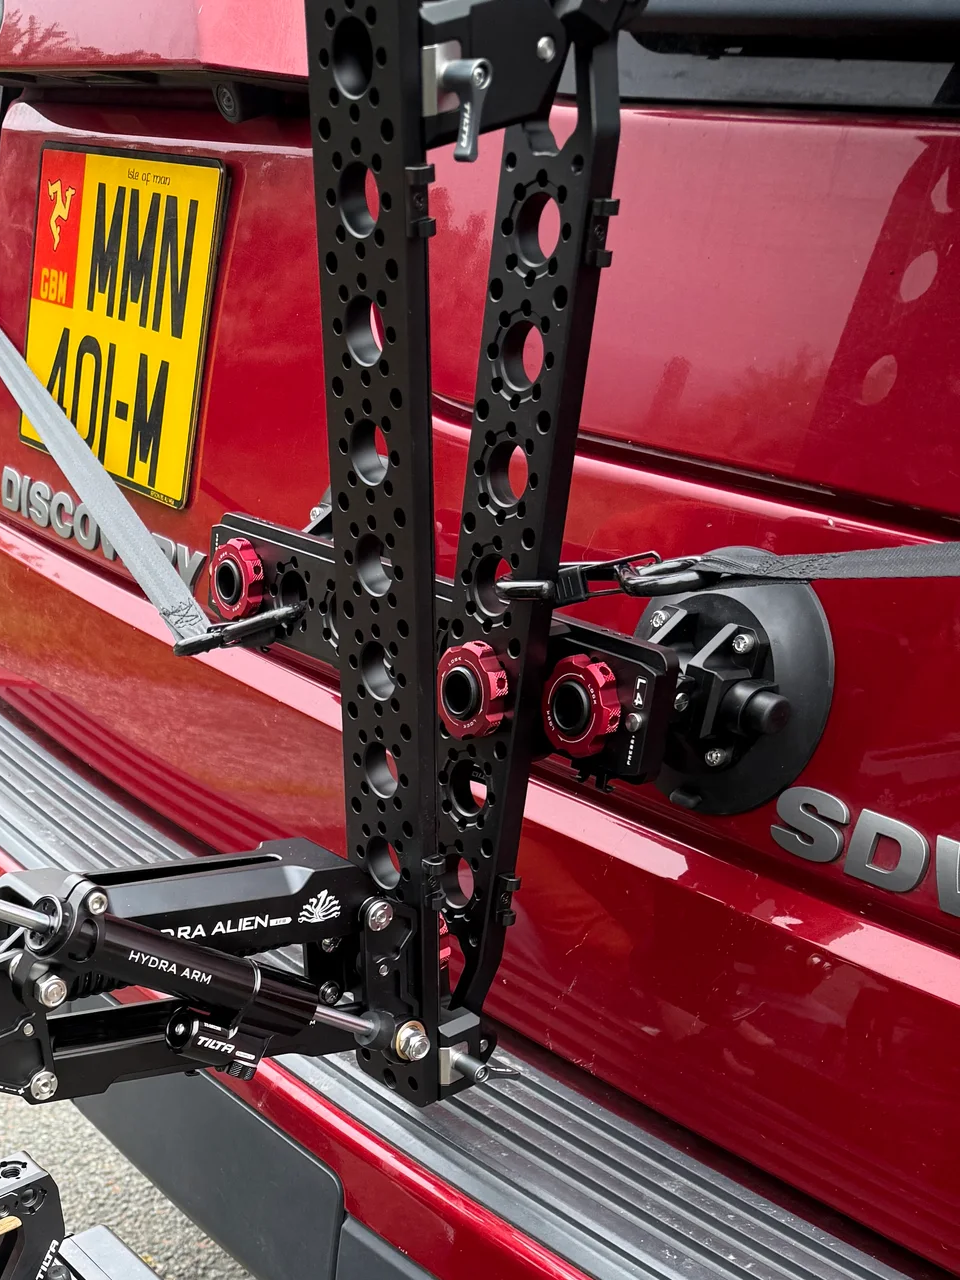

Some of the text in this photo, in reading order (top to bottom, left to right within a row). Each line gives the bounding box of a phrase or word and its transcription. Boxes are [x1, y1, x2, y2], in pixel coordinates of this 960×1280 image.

[141, 172, 152, 186] of
[87, 182, 199, 340] MMN
[40, 267, 68, 305] GBM
[211, 914, 269, 936] ALIEN
[128, 950, 212, 985] HYDRA ARM
[197, 1036, 235, 1054] TILTA
[35, 1239, 60, 1280] TILTA
